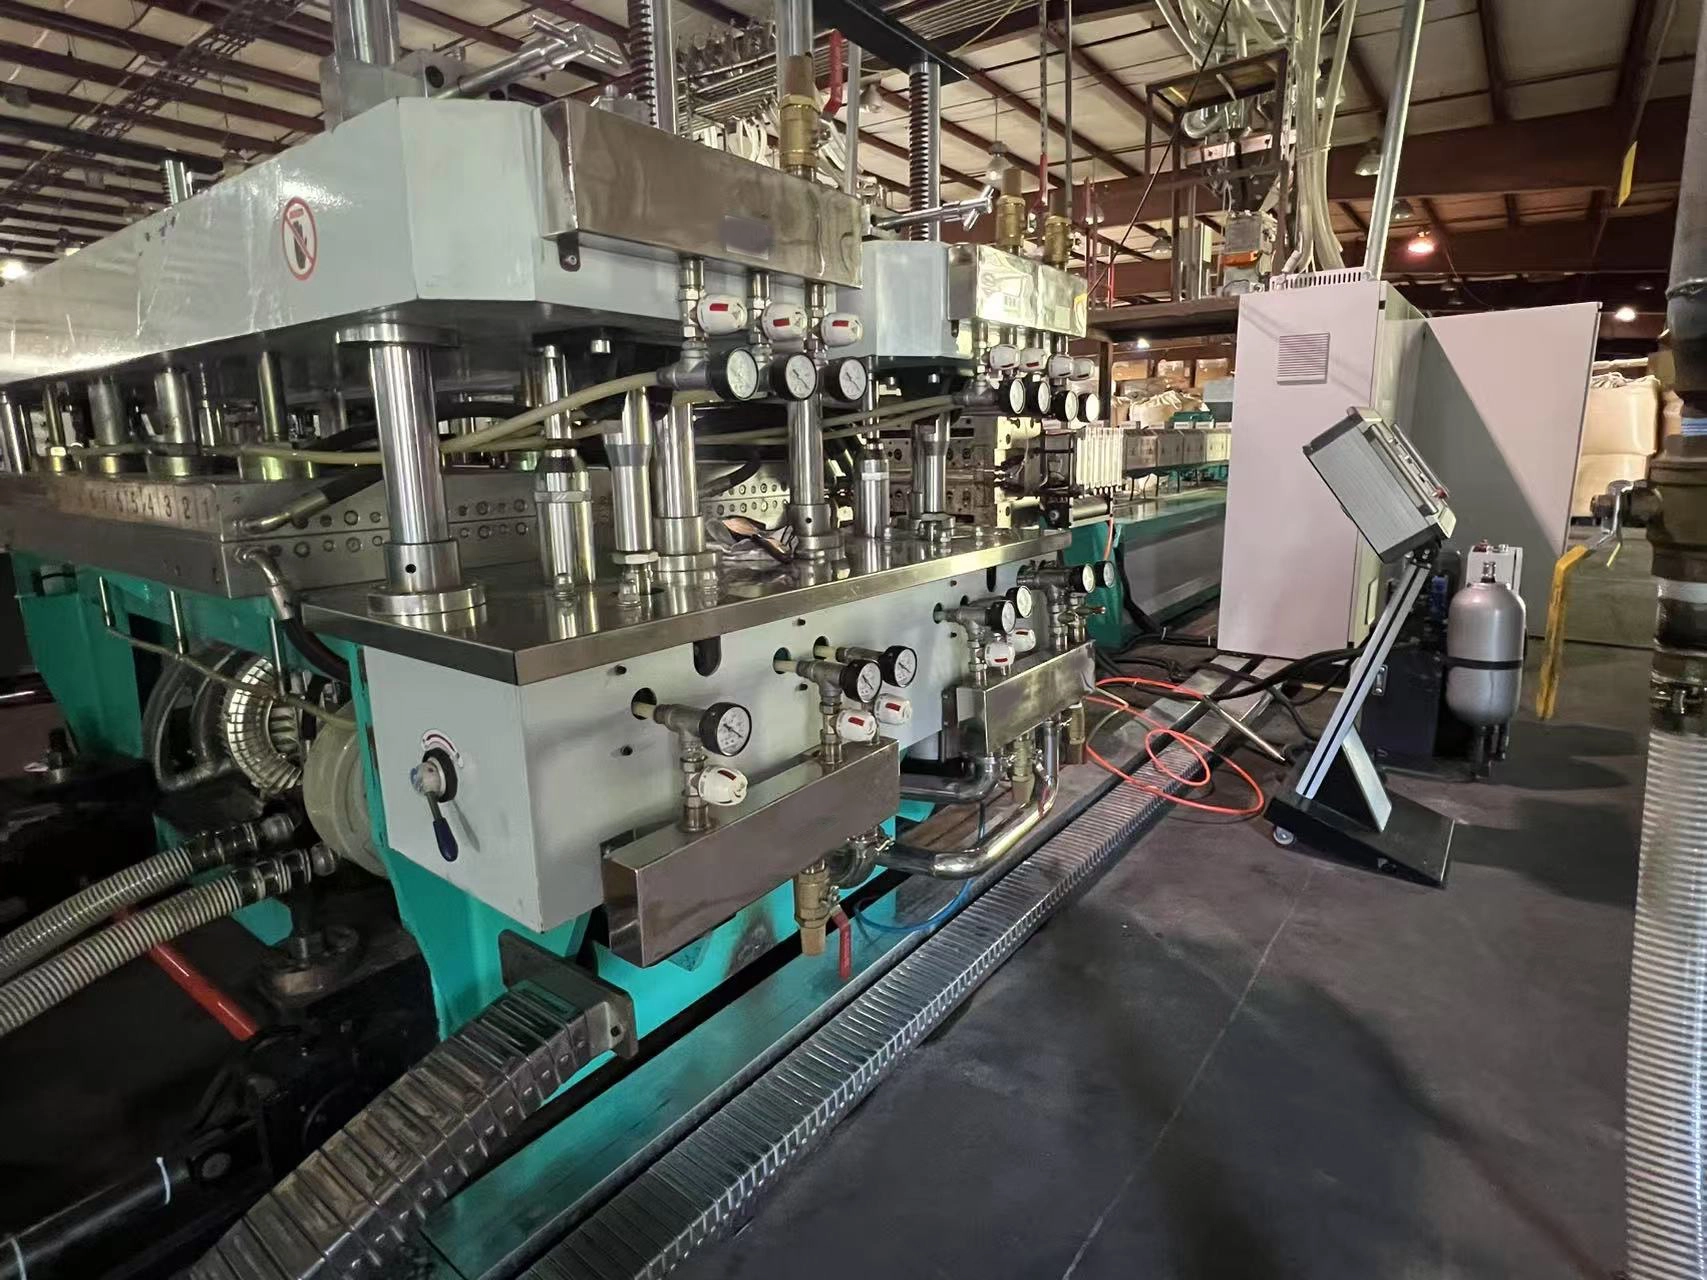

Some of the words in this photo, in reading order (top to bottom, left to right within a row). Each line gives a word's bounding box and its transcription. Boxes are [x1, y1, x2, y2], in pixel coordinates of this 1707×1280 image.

[147, 492, 155, 517] 4
[163, 494, 173, 518] 3
[181, 495, 191, 520] 2
